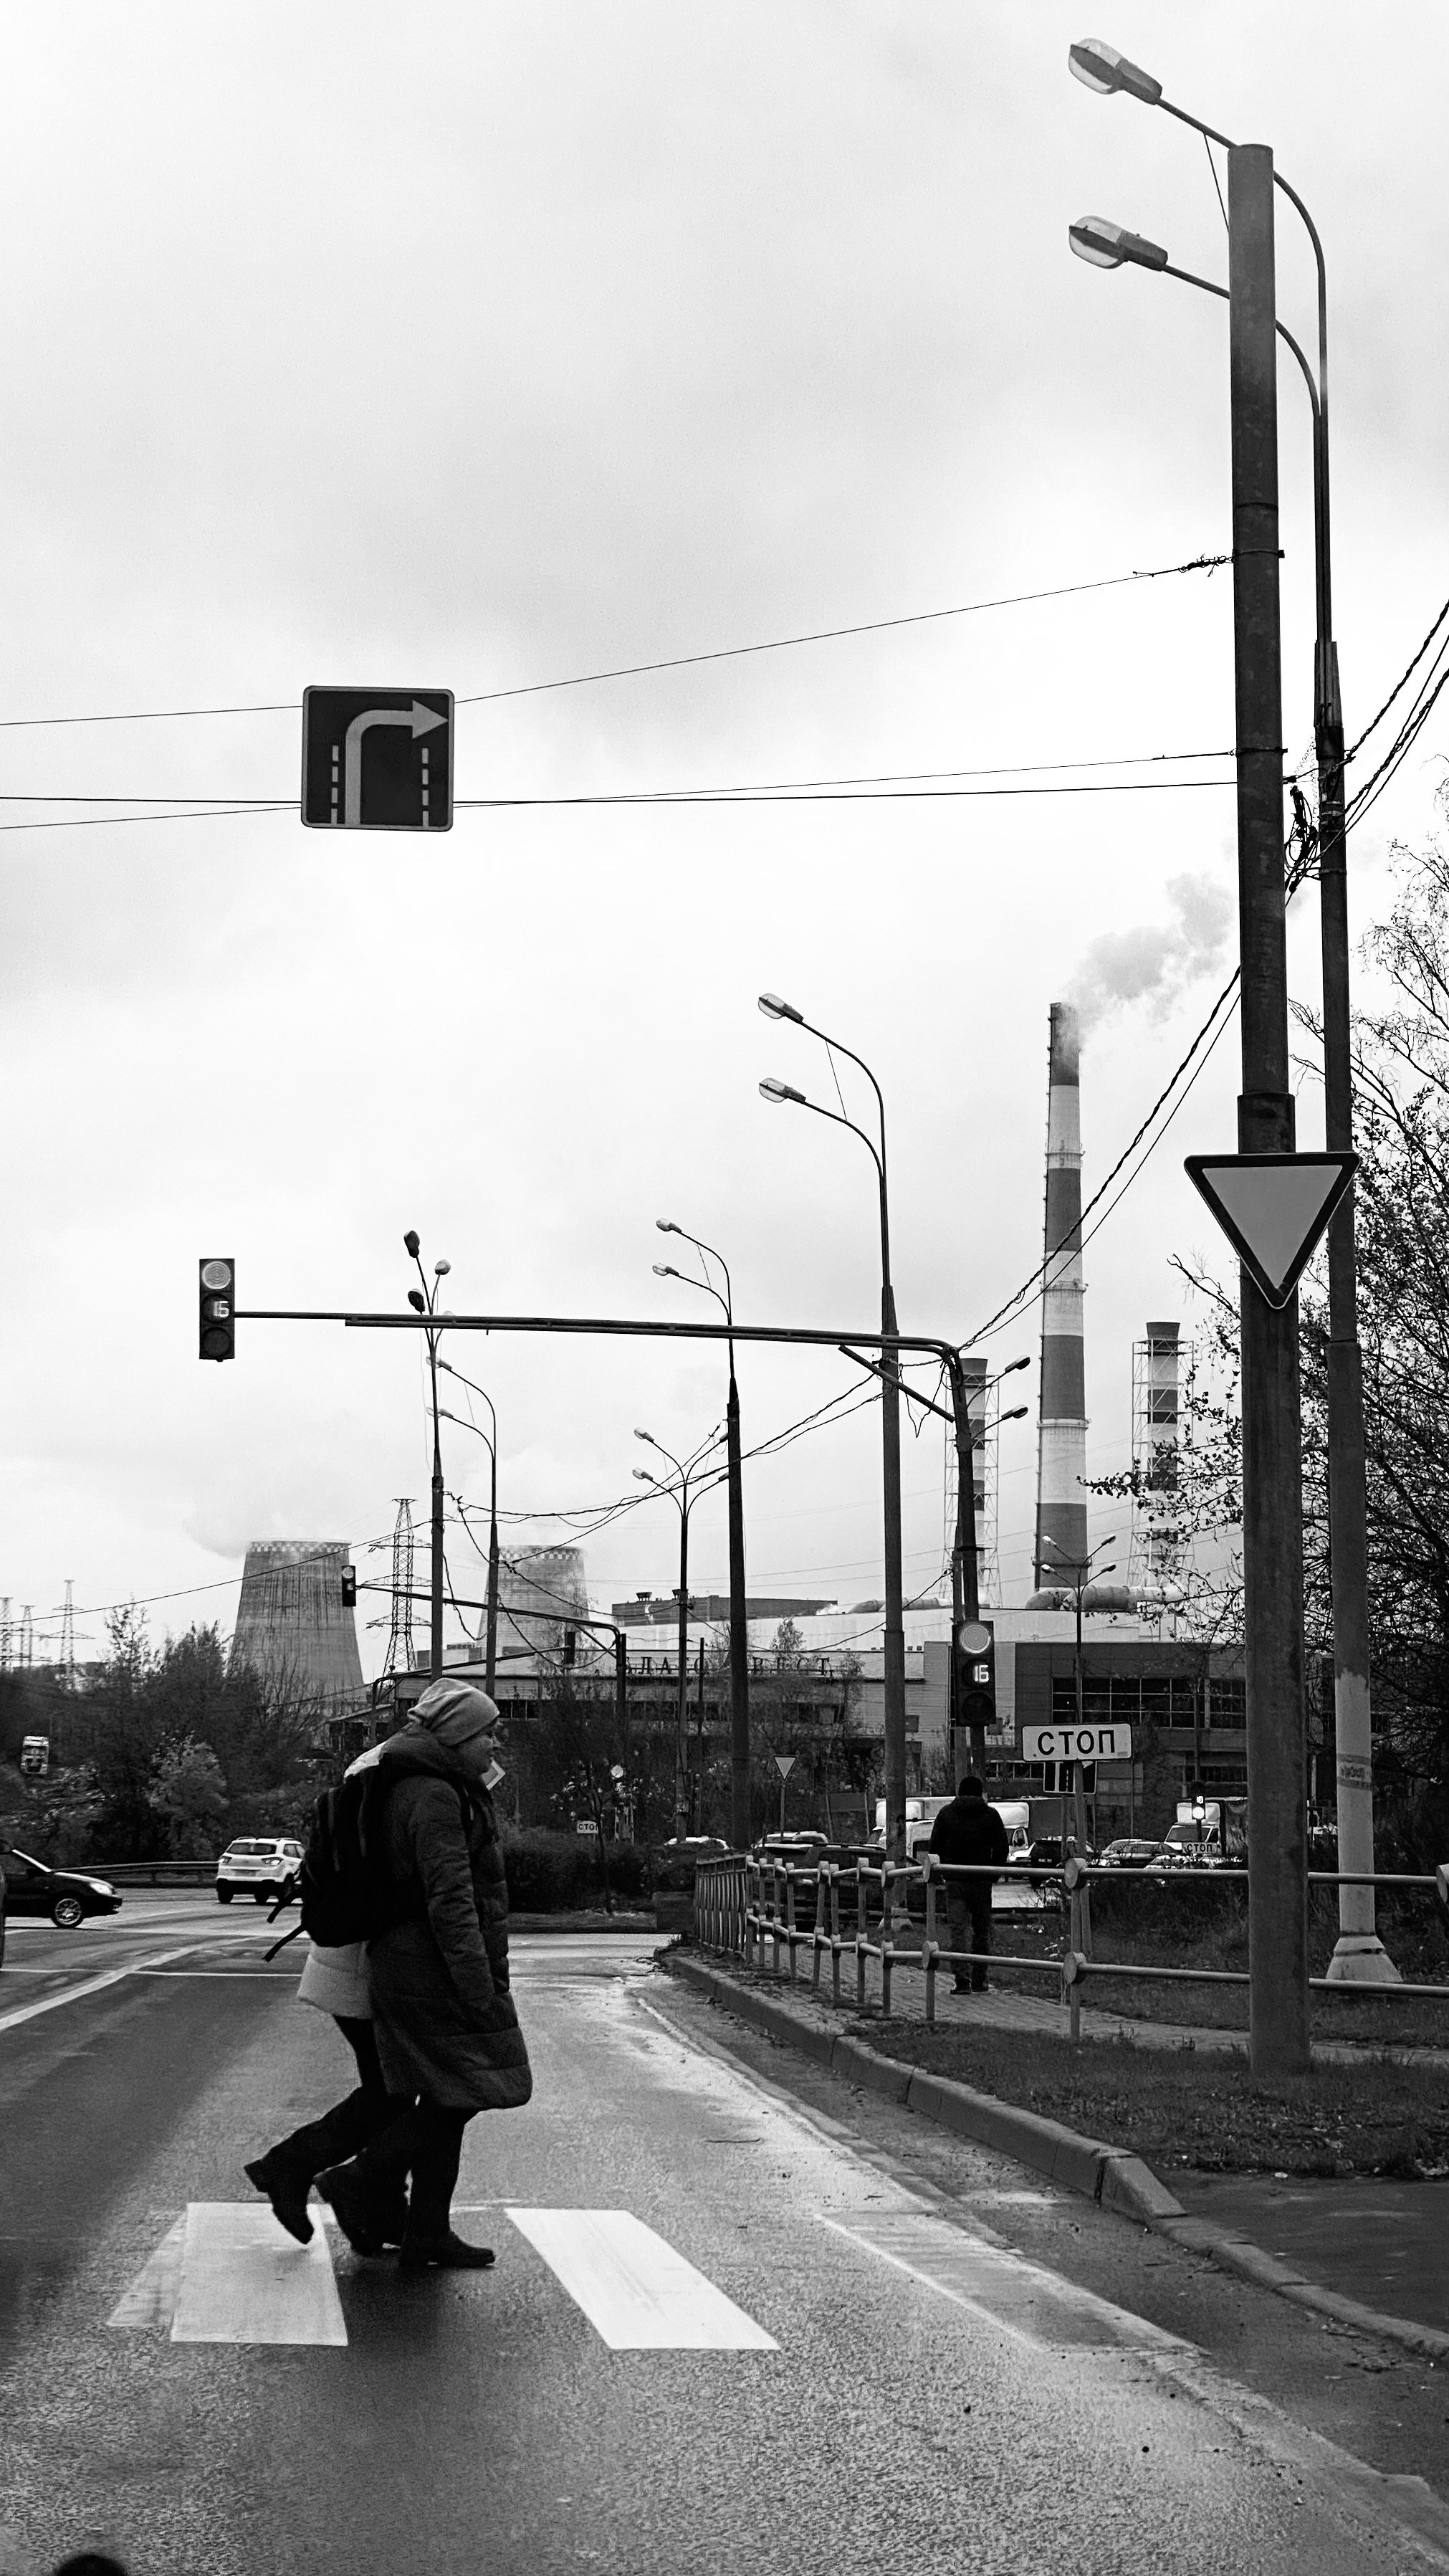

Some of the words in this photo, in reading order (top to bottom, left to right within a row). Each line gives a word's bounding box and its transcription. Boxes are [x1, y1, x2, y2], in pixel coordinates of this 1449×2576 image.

[974, 1664, 990, 1682] 16
[1037, 1730, 1115, 1755] СТОП
[1187, 1843, 1213, 1853] СТОП
